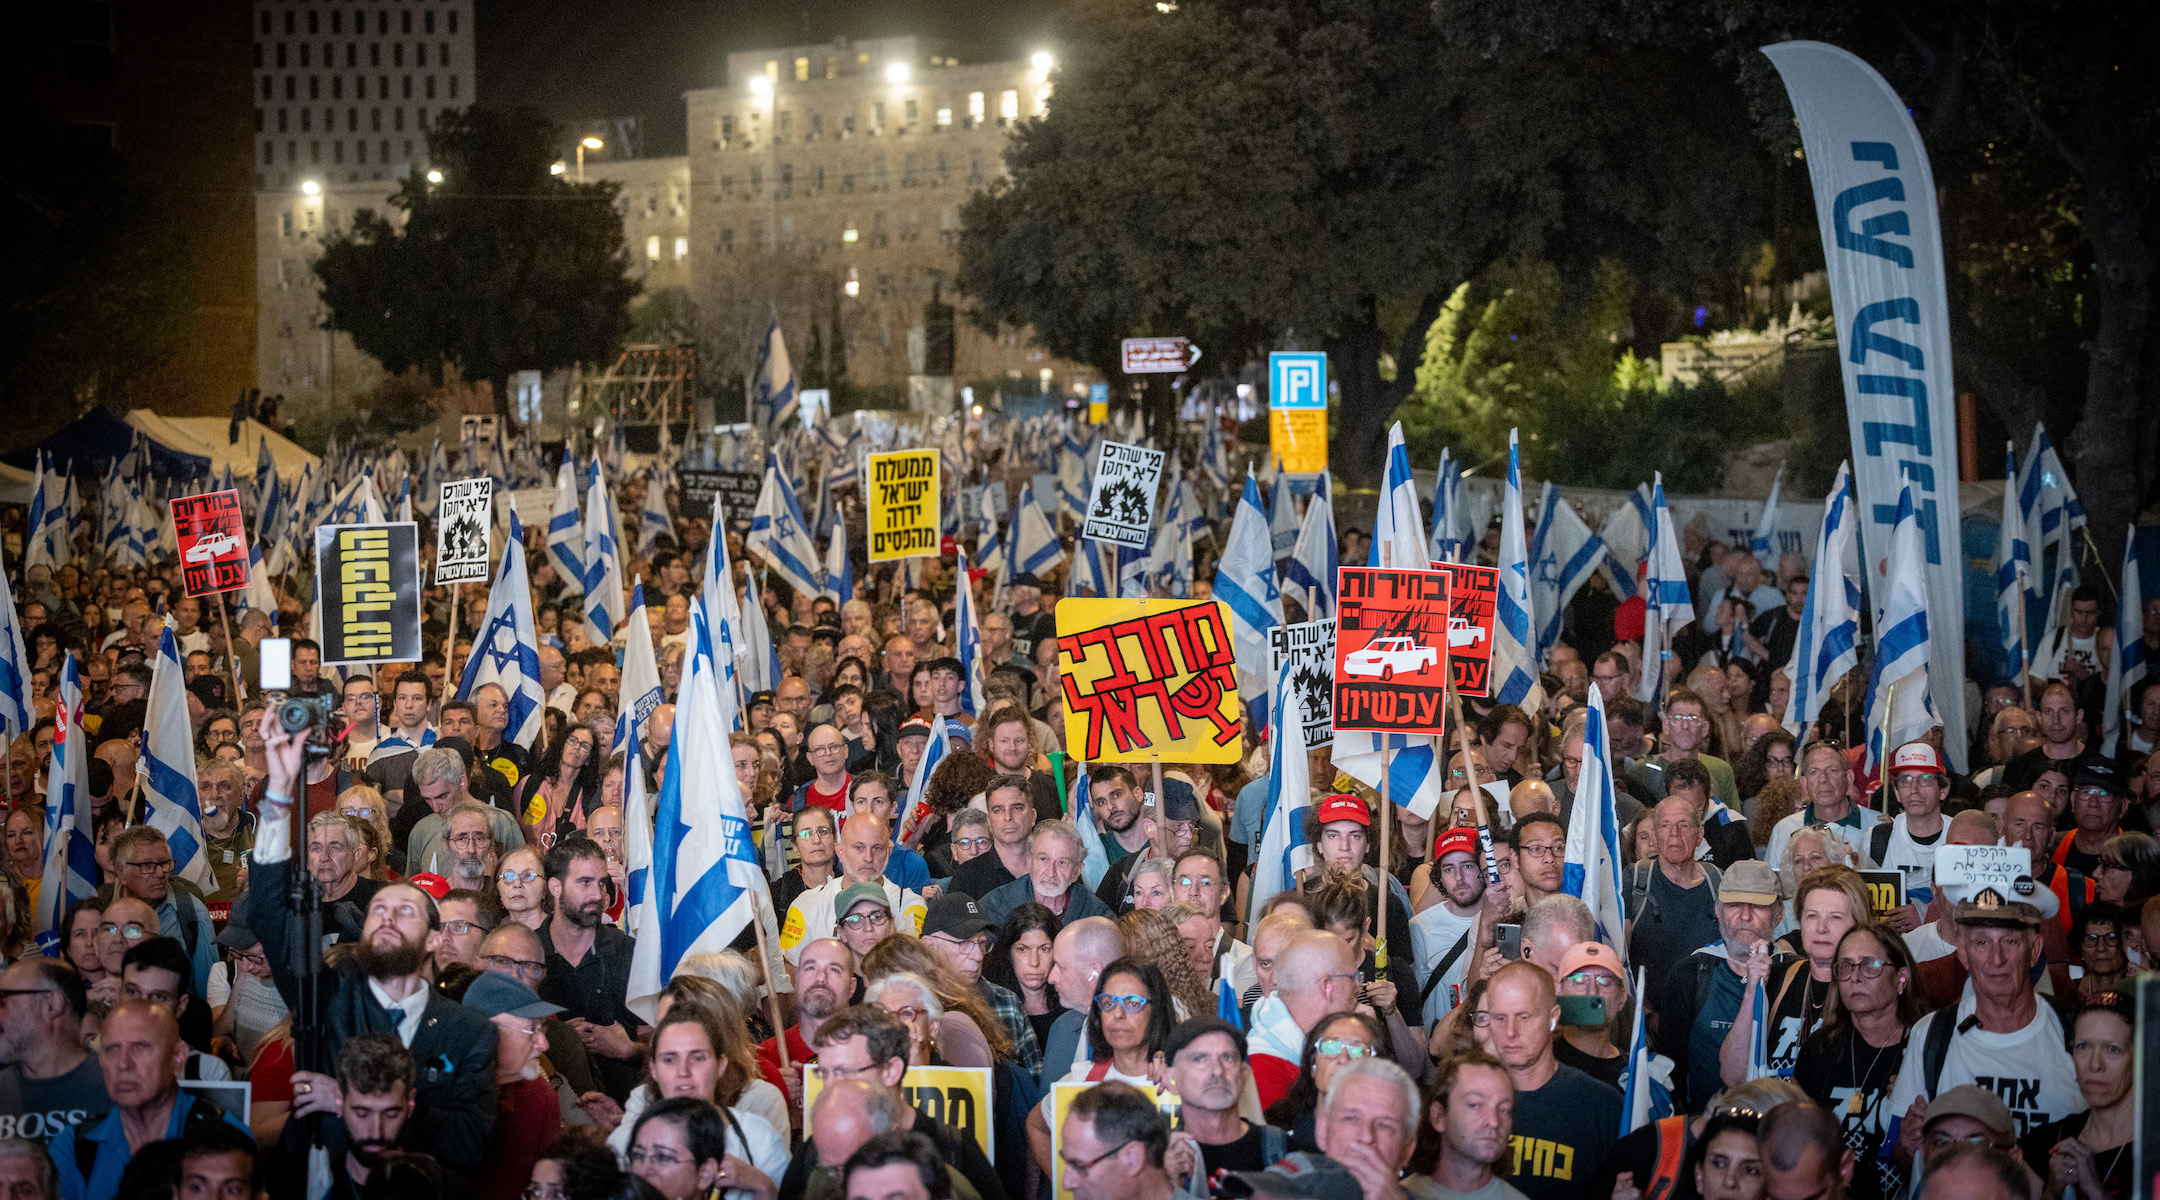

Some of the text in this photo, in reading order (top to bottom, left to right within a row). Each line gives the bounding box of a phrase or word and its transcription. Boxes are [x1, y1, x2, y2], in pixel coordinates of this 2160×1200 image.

[875, 456, 933, 482] ממשלת
[1100, 460, 1158, 483] לא יתקן
[1144, 451, 1162, 468] מי
[474, 480, 490, 496] מי
[879, 480, 929, 505] ישראל
[173, 492, 239, 518] בחירות
[443, 495, 488, 519] לא יתקן
[886, 504, 922, 528] ירדה
[873, 527, 936, 554] מהפסים
[187, 561, 247, 592] עכשיו!
[1339, 571, 1448, 602] בחירות
[340, 529, 397, 658] הופקרנו!
[1340, 687, 1441, 726] עכשיו!
[1953, 860, 2023, 873] מטביע את
[1963, 847, 2008, 862] הקפטן
[0, 1109, 87, 1139] BOSS
